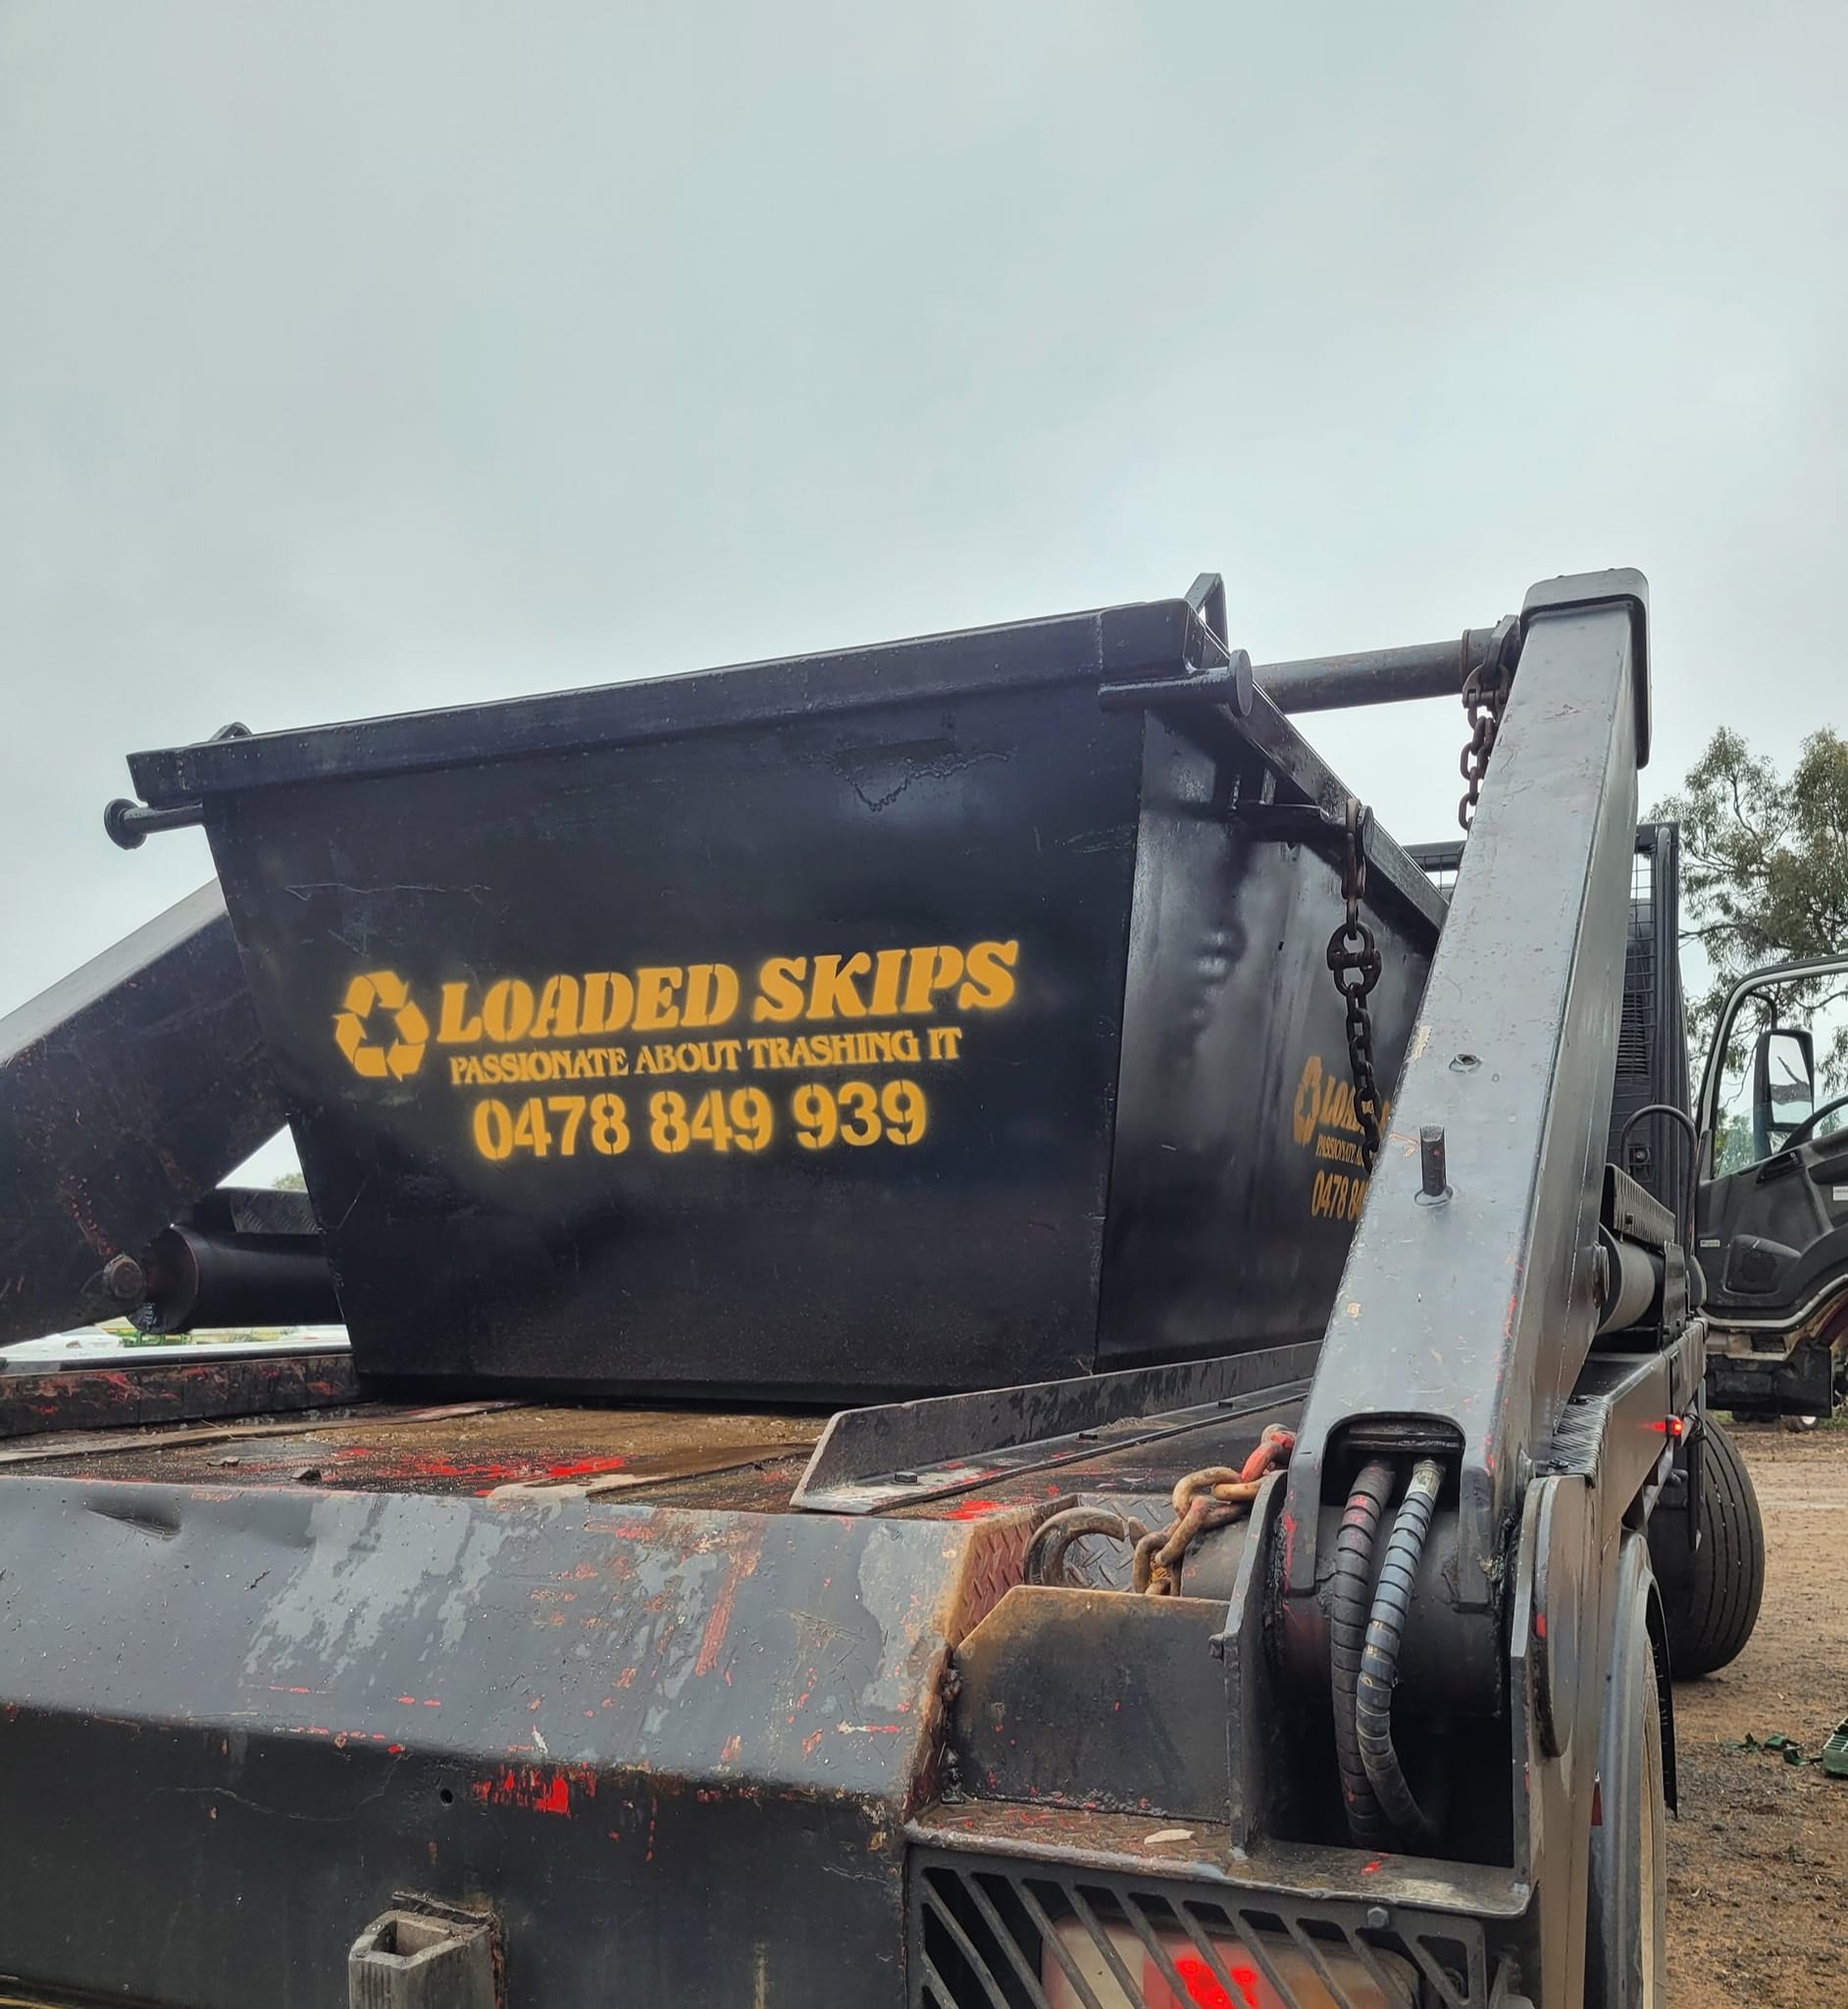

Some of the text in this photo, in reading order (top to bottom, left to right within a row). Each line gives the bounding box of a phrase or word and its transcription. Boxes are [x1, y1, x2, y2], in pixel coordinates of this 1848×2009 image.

[436, 941, 1018, 1045] LOADED SKIPS
[448, 1027, 961, 1086] PASSIONATE ABOUT TRASHING IT
[472, 1080, 927, 1162] 0478 849 939
[1311, 1169, 1369, 1221] 0478 84
